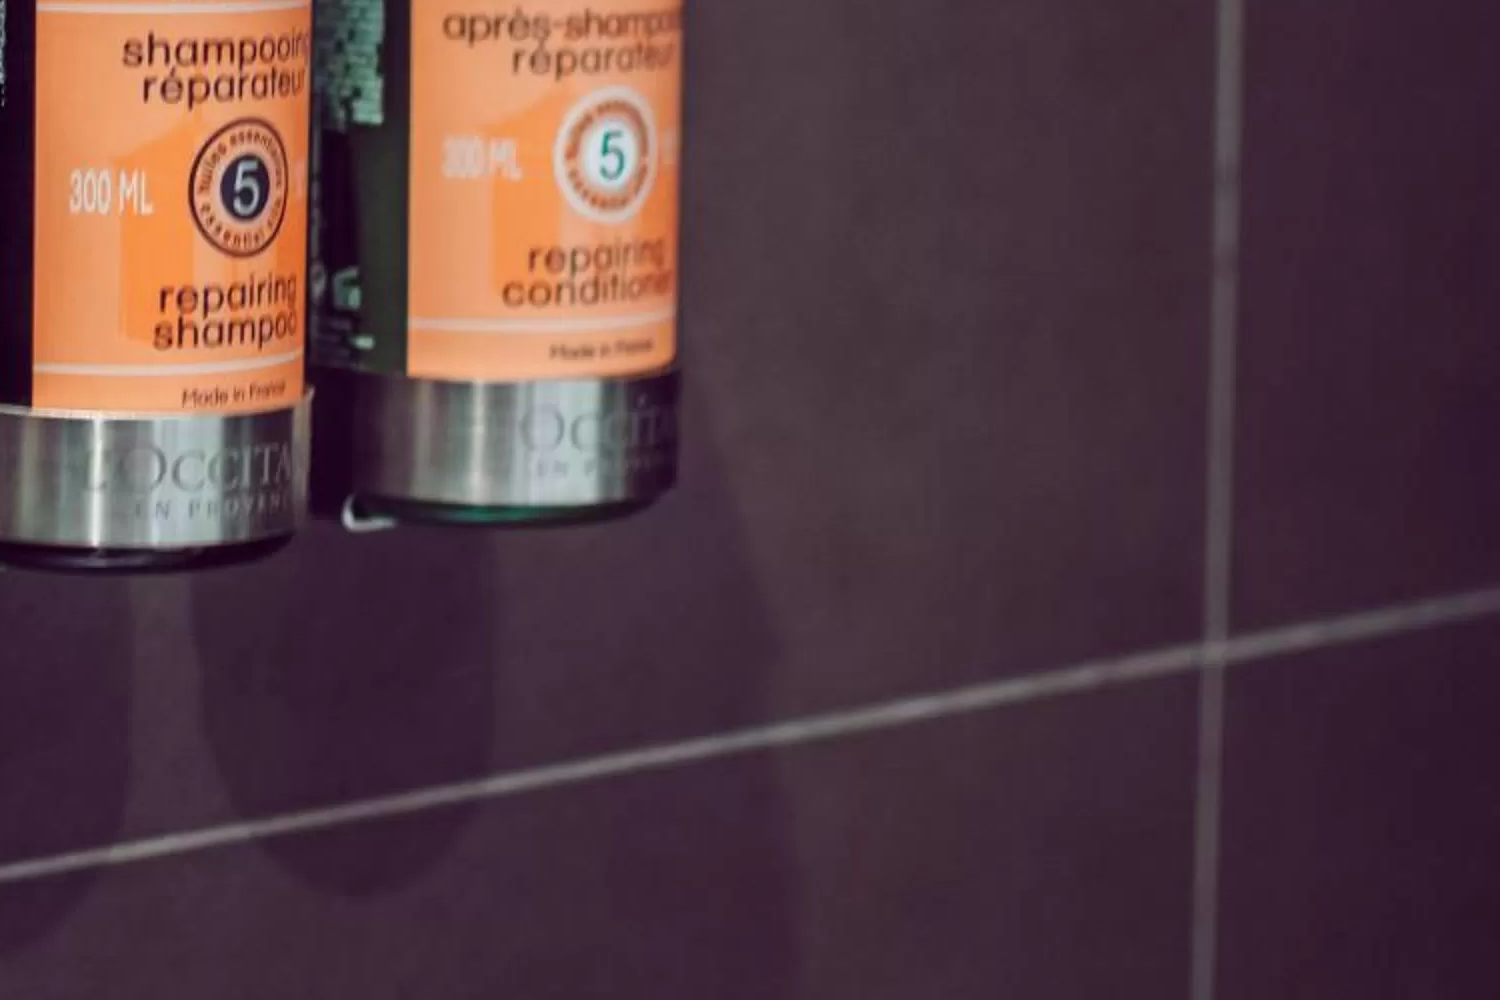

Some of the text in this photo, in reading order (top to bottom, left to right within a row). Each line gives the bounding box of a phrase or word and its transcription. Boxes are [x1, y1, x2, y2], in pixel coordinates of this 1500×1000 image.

[598, 129, 626, 181] 5
[68, 167, 154, 216] 300 ML
[233, 159, 260, 217] 5
[159, 271, 297, 320] repairing
[153, 310, 297, 352] shampoo
